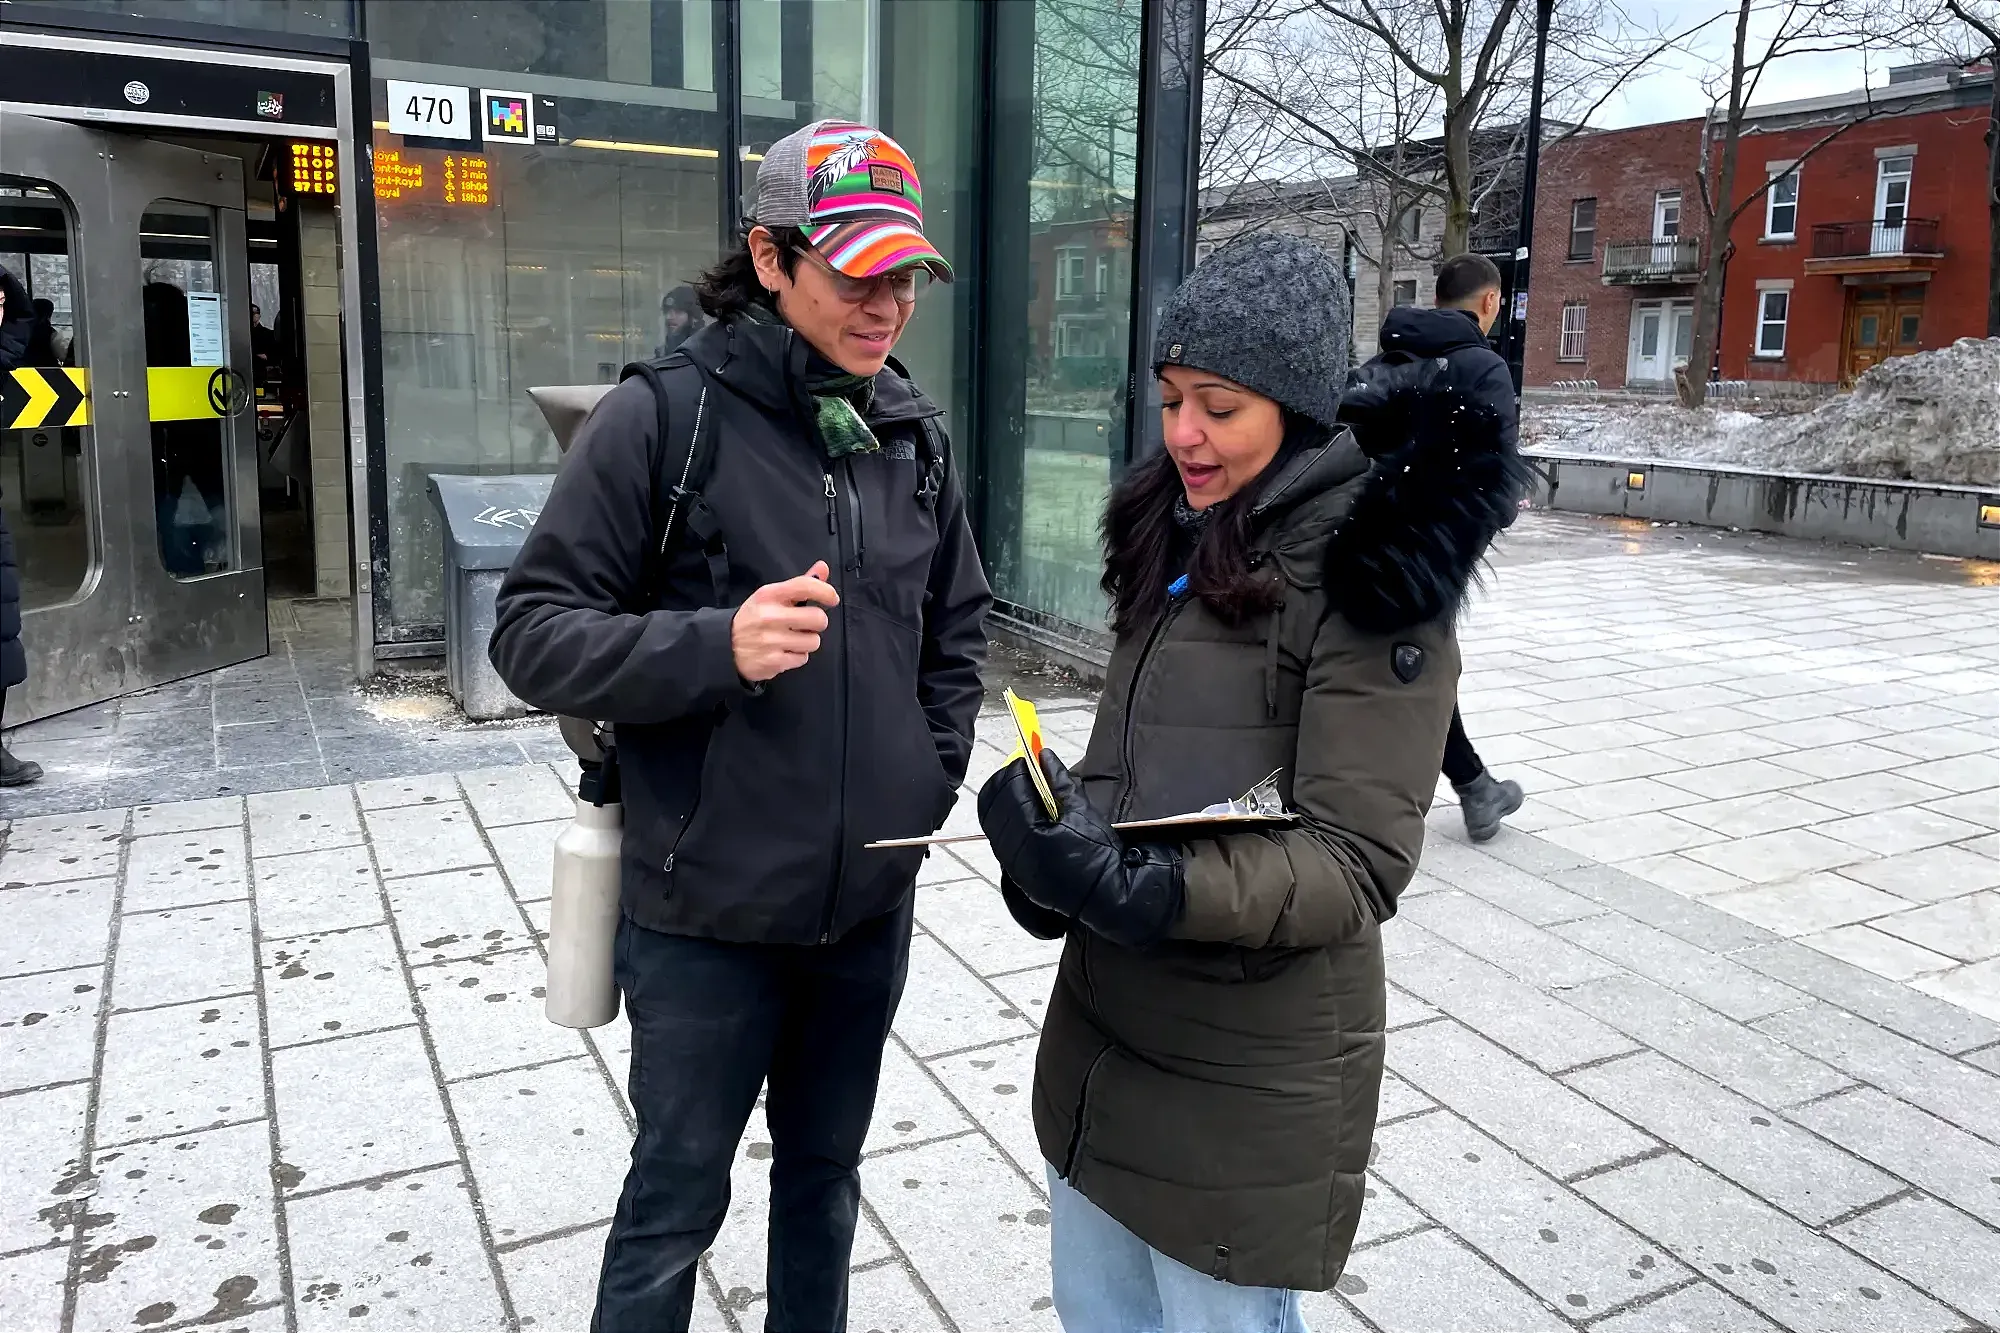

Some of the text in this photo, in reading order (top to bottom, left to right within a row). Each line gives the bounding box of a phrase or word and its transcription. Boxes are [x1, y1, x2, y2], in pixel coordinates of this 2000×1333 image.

[406, 96, 453, 124] 470
[292, 145, 309, 155] 97
[313, 146, 321, 156] E
[325, 147, 334, 157] D
[461, 158, 467, 167] 2
[470, 159, 487, 168] min
[294, 157, 308, 167] 11
[325, 159, 334, 169] P
[375, 164, 422, 176] ont-Royal
[461, 170, 468, 178] 3
[470, 171, 487, 179] min
[873, 168, 900, 180] NATIVE
[294, 170, 488, 191] 11 E P ont-Royal 18h04
[875, 178, 901, 189] PRIDE
[294, 182, 310, 192] 97
[315, 183, 322, 192] E
[326, 184, 335, 193] D
[461, 193, 488, 203] 18h10
[885, 452, 906, 460] FACE
